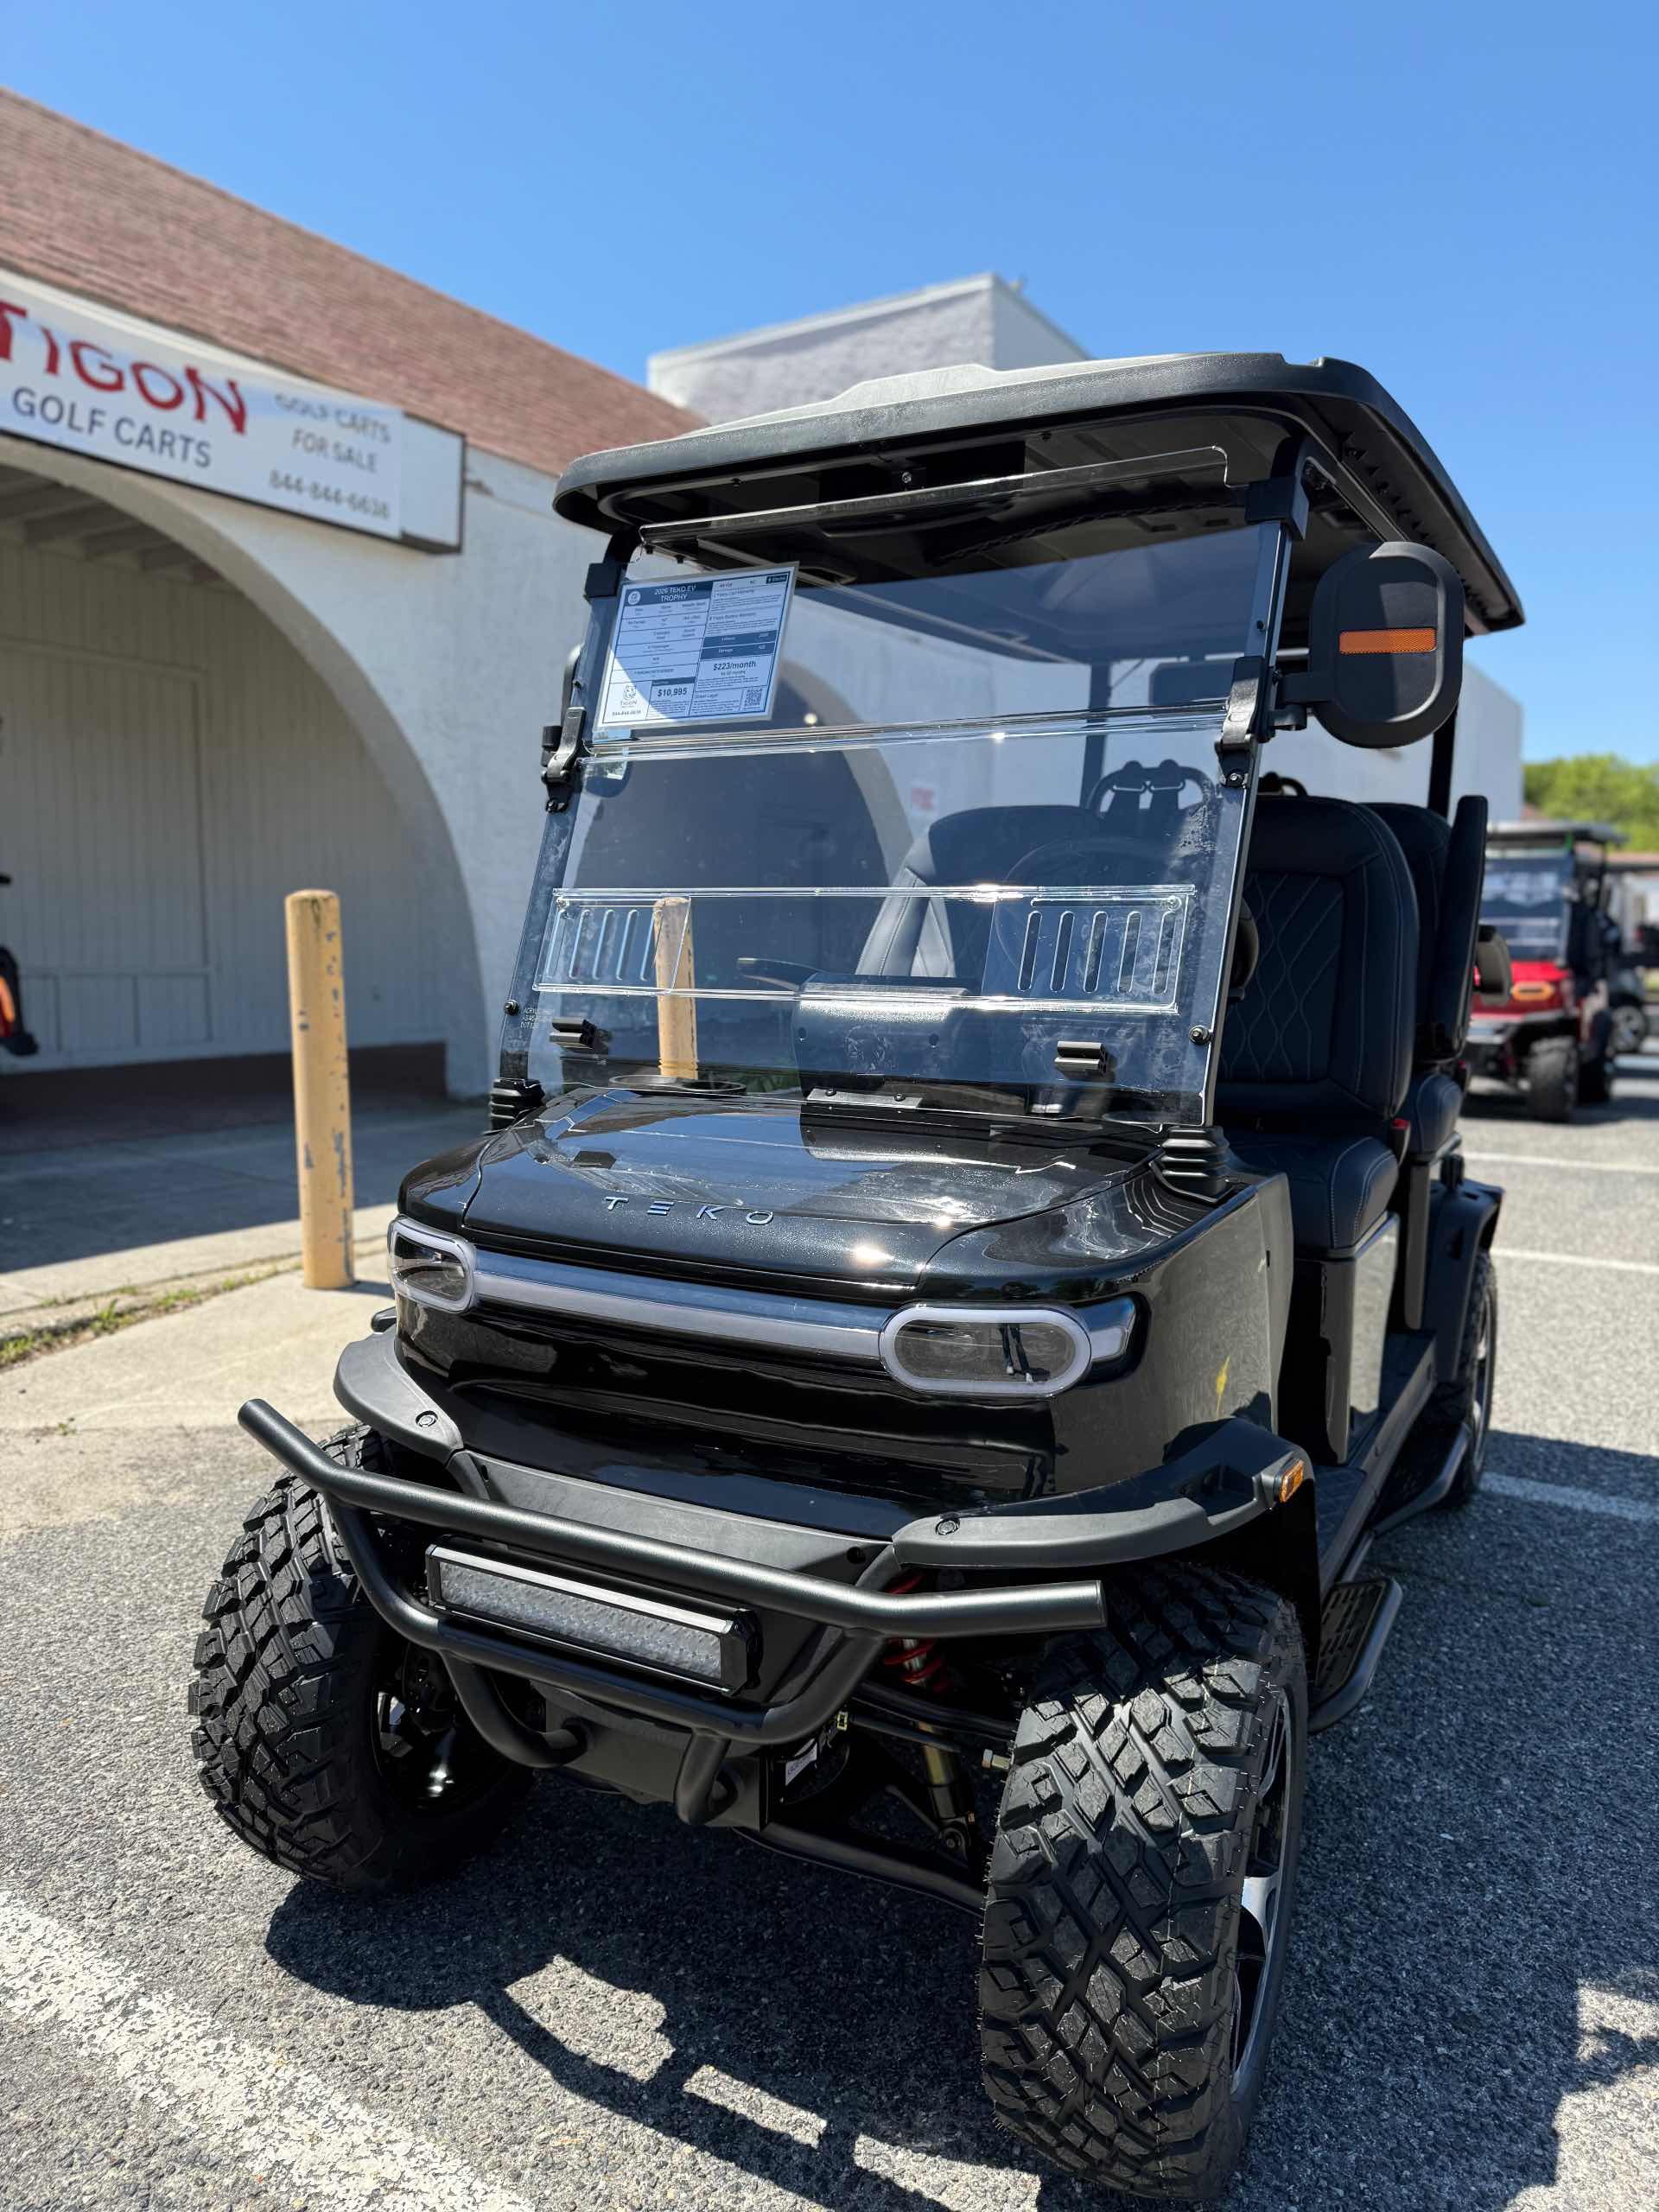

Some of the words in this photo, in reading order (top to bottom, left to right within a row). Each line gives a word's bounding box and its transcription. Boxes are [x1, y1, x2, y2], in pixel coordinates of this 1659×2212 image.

[0, 299, 247, 435] TIGON
[11, 386, 107, 435] GOLF
[113, 416, 213, 469] CARTS
[334, 410, 391, 444] CARTS
[291, 428, 330, 459] FOR
[332, 442, 378, 474] SALE
[661, 594, 688, 602] TROPHY
[670, 586, 687, 594] TEKO
[713, 660, 757, 671] $223/month
[657, 687, 689, 698] $10,995
[605, 1196, 774, 1226] TEKO
